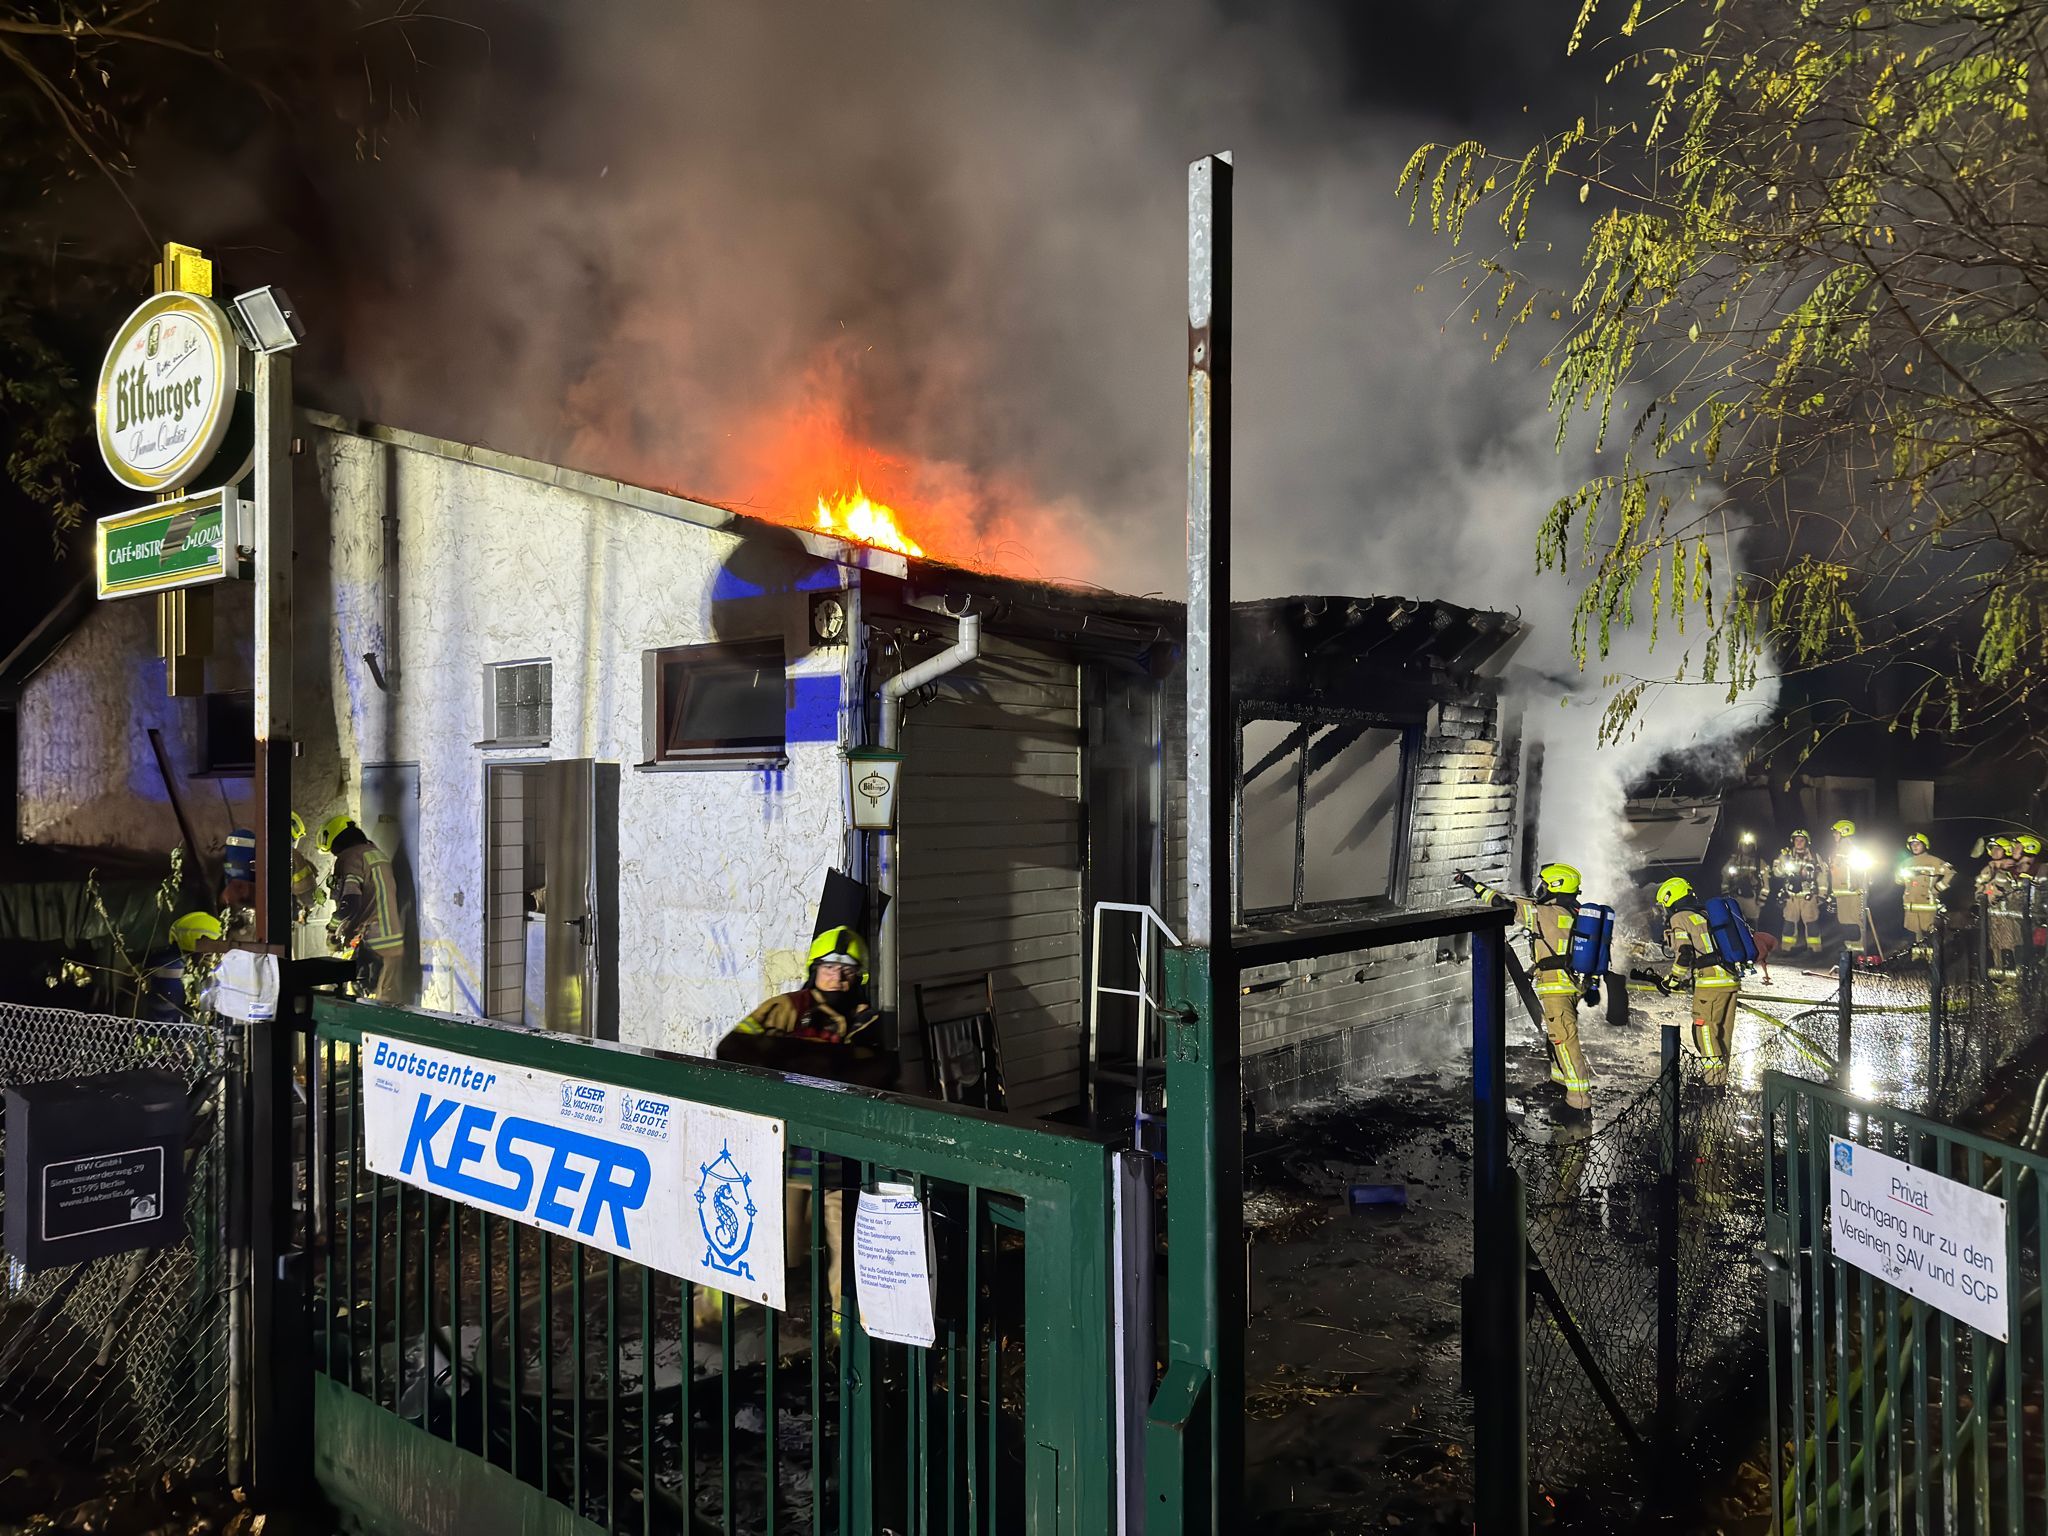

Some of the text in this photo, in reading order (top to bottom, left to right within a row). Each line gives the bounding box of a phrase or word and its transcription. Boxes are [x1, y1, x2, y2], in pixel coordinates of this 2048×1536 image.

[116, 360, 202, 433] Bitburger
[373, 1041, 497, 1093] Bootscenter
[575, 1085, 605, 1102] KESER
[572, 1100, 604, 1114] YACHTEN
[635, 1099, 670, 1117] KESER
[632, 1113, 668, 1129] BOOTE
[400, 1092, 652, 1250] KESER
[100, 1180, 126, 1190] Berlin
[1891, 1177, 1929, 1210] Privat
[893, 1201, 920, 1209] KESER
[1840, 1188, 1994, 1274] Durchgang nur zu den
[1839, 1215, 1999, 1306] Vereinen SAV und SCP
